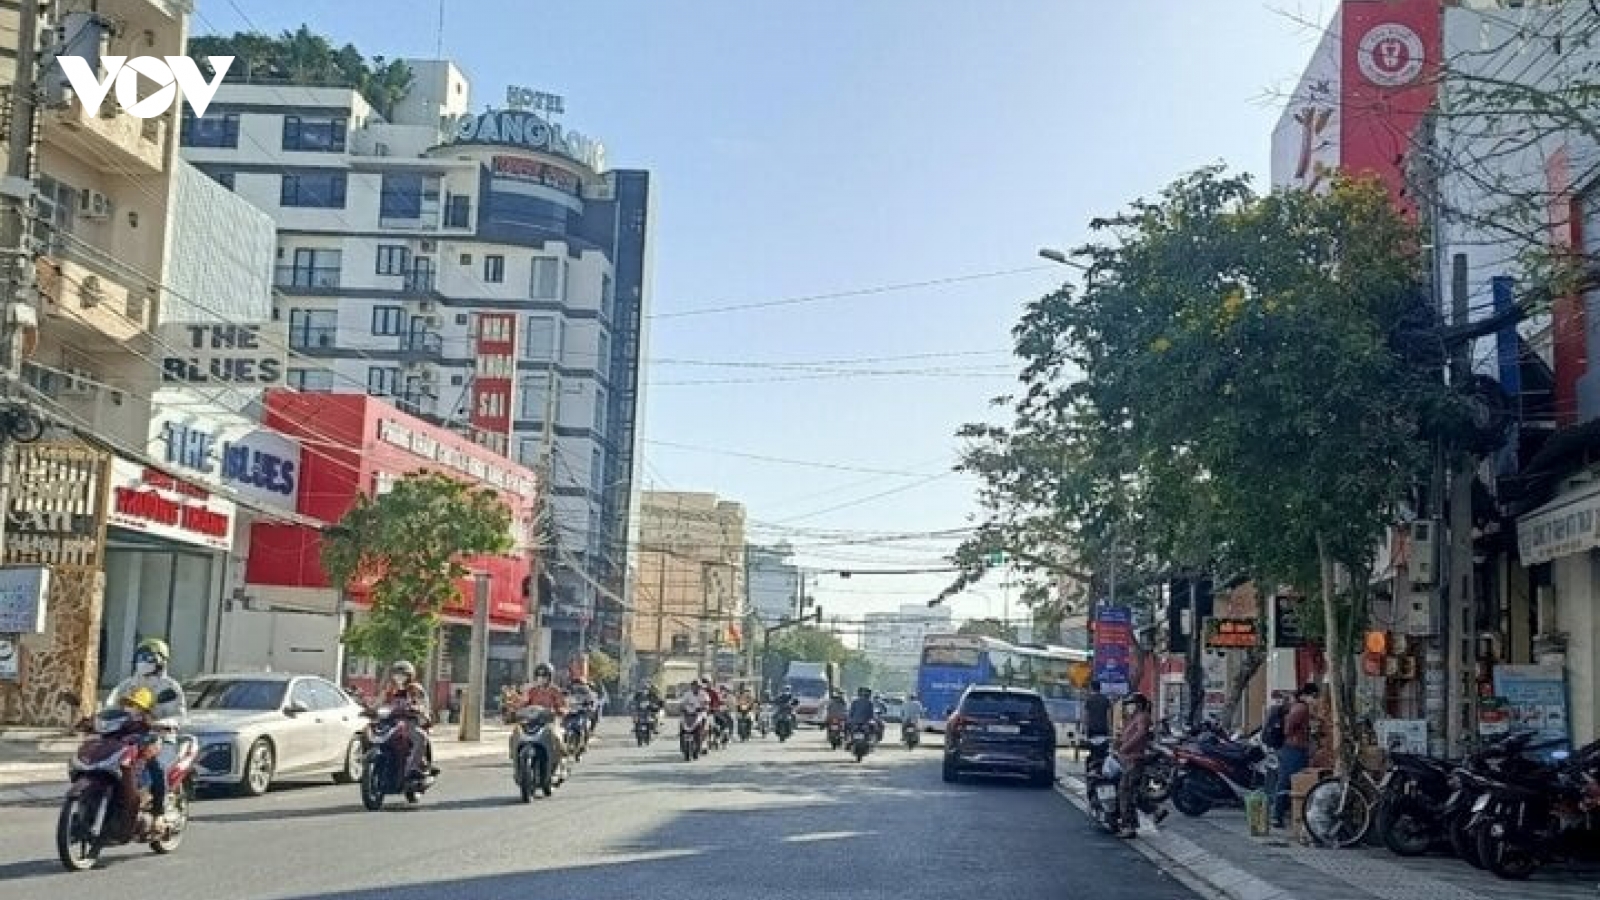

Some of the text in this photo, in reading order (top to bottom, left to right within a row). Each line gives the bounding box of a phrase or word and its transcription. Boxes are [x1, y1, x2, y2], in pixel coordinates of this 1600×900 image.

[507, 85, 565, 113] HOTEL
[187, 325, 260, 349] THE
[163, 357, 281, 382] BLUES
[162, 421, 214, 473] THE
[221, 441, 294, 495] BLUES
